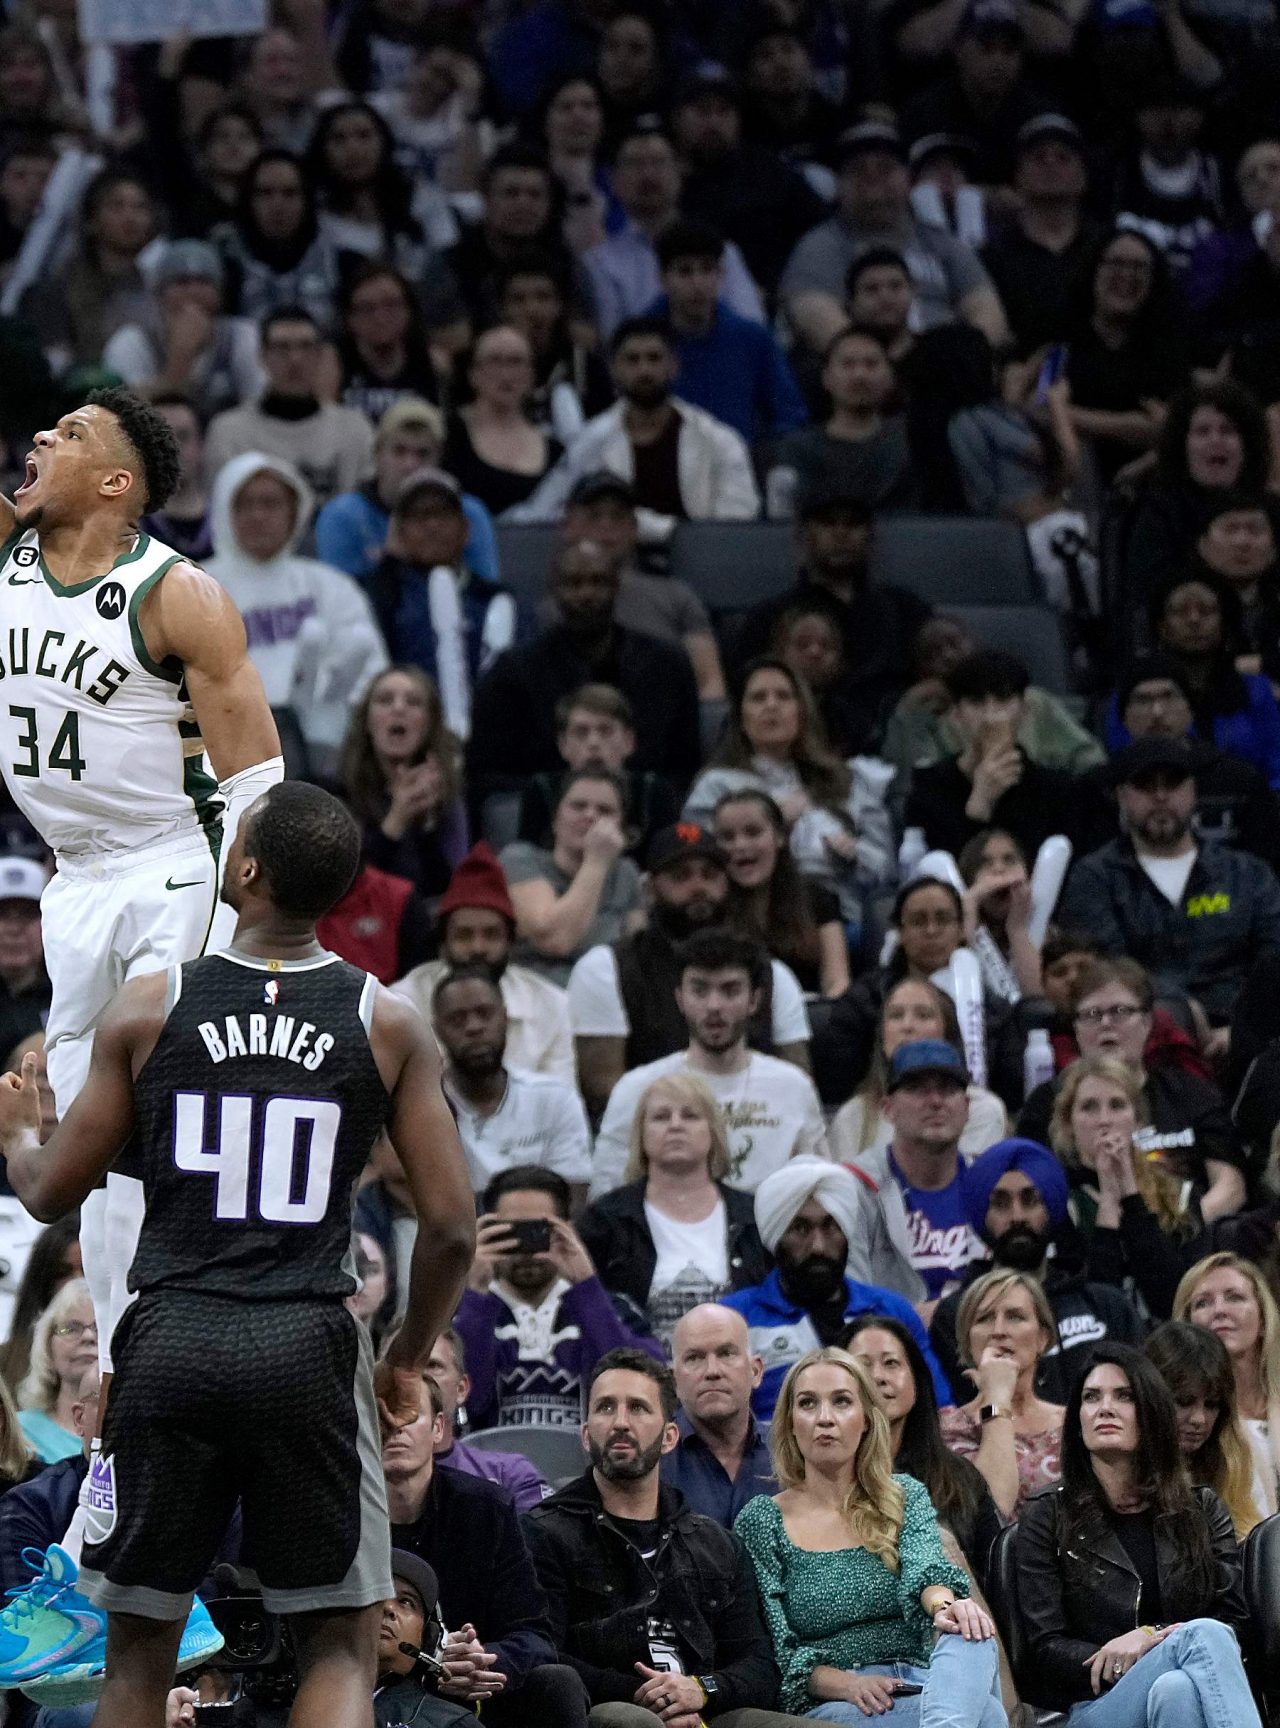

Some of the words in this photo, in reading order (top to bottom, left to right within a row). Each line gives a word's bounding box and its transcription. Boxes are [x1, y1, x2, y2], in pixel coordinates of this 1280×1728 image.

[17, 547, 34, 566] 6
[8, 704, 87, 781] 34
[197, 1013, 335, 1072] BARNES
[173, 1092, 342, 1224] 40
[500, 1407, 581, 1427] KINGS
